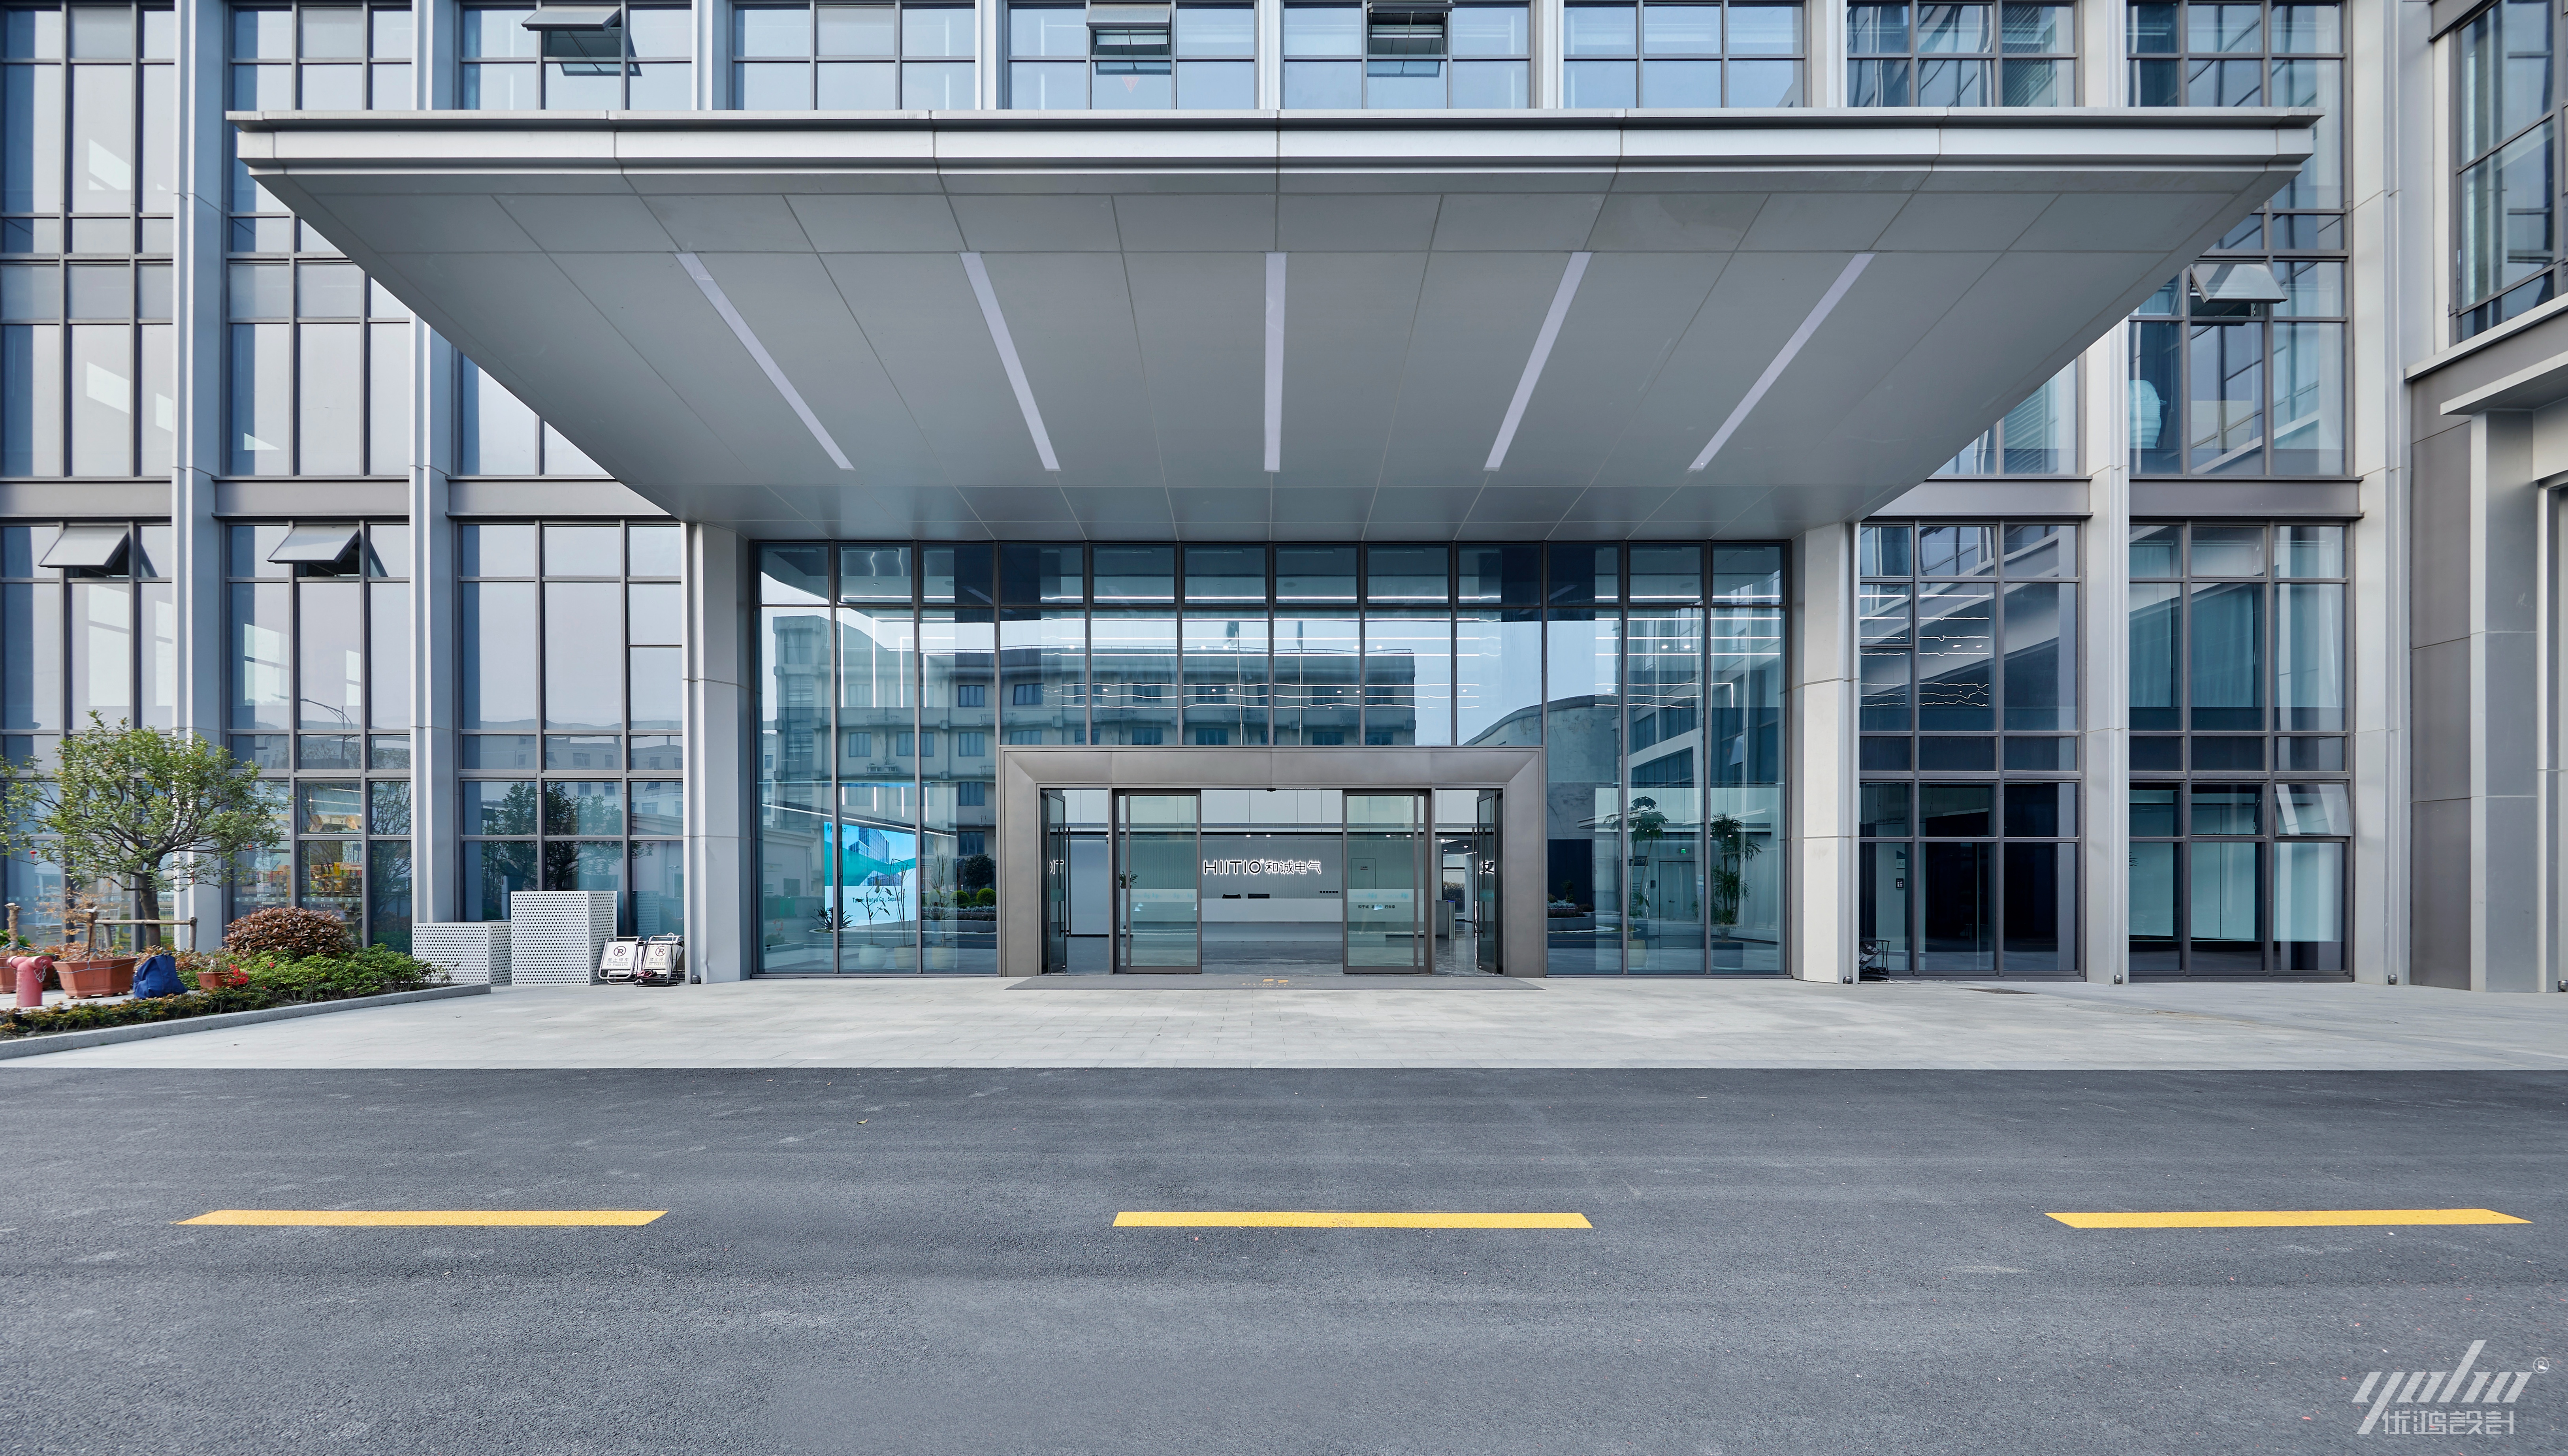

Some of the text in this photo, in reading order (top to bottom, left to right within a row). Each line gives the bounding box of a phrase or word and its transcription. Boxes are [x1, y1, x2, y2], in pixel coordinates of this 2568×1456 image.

[1204, 861, 1321, 874] HIITIO 和诚电气
